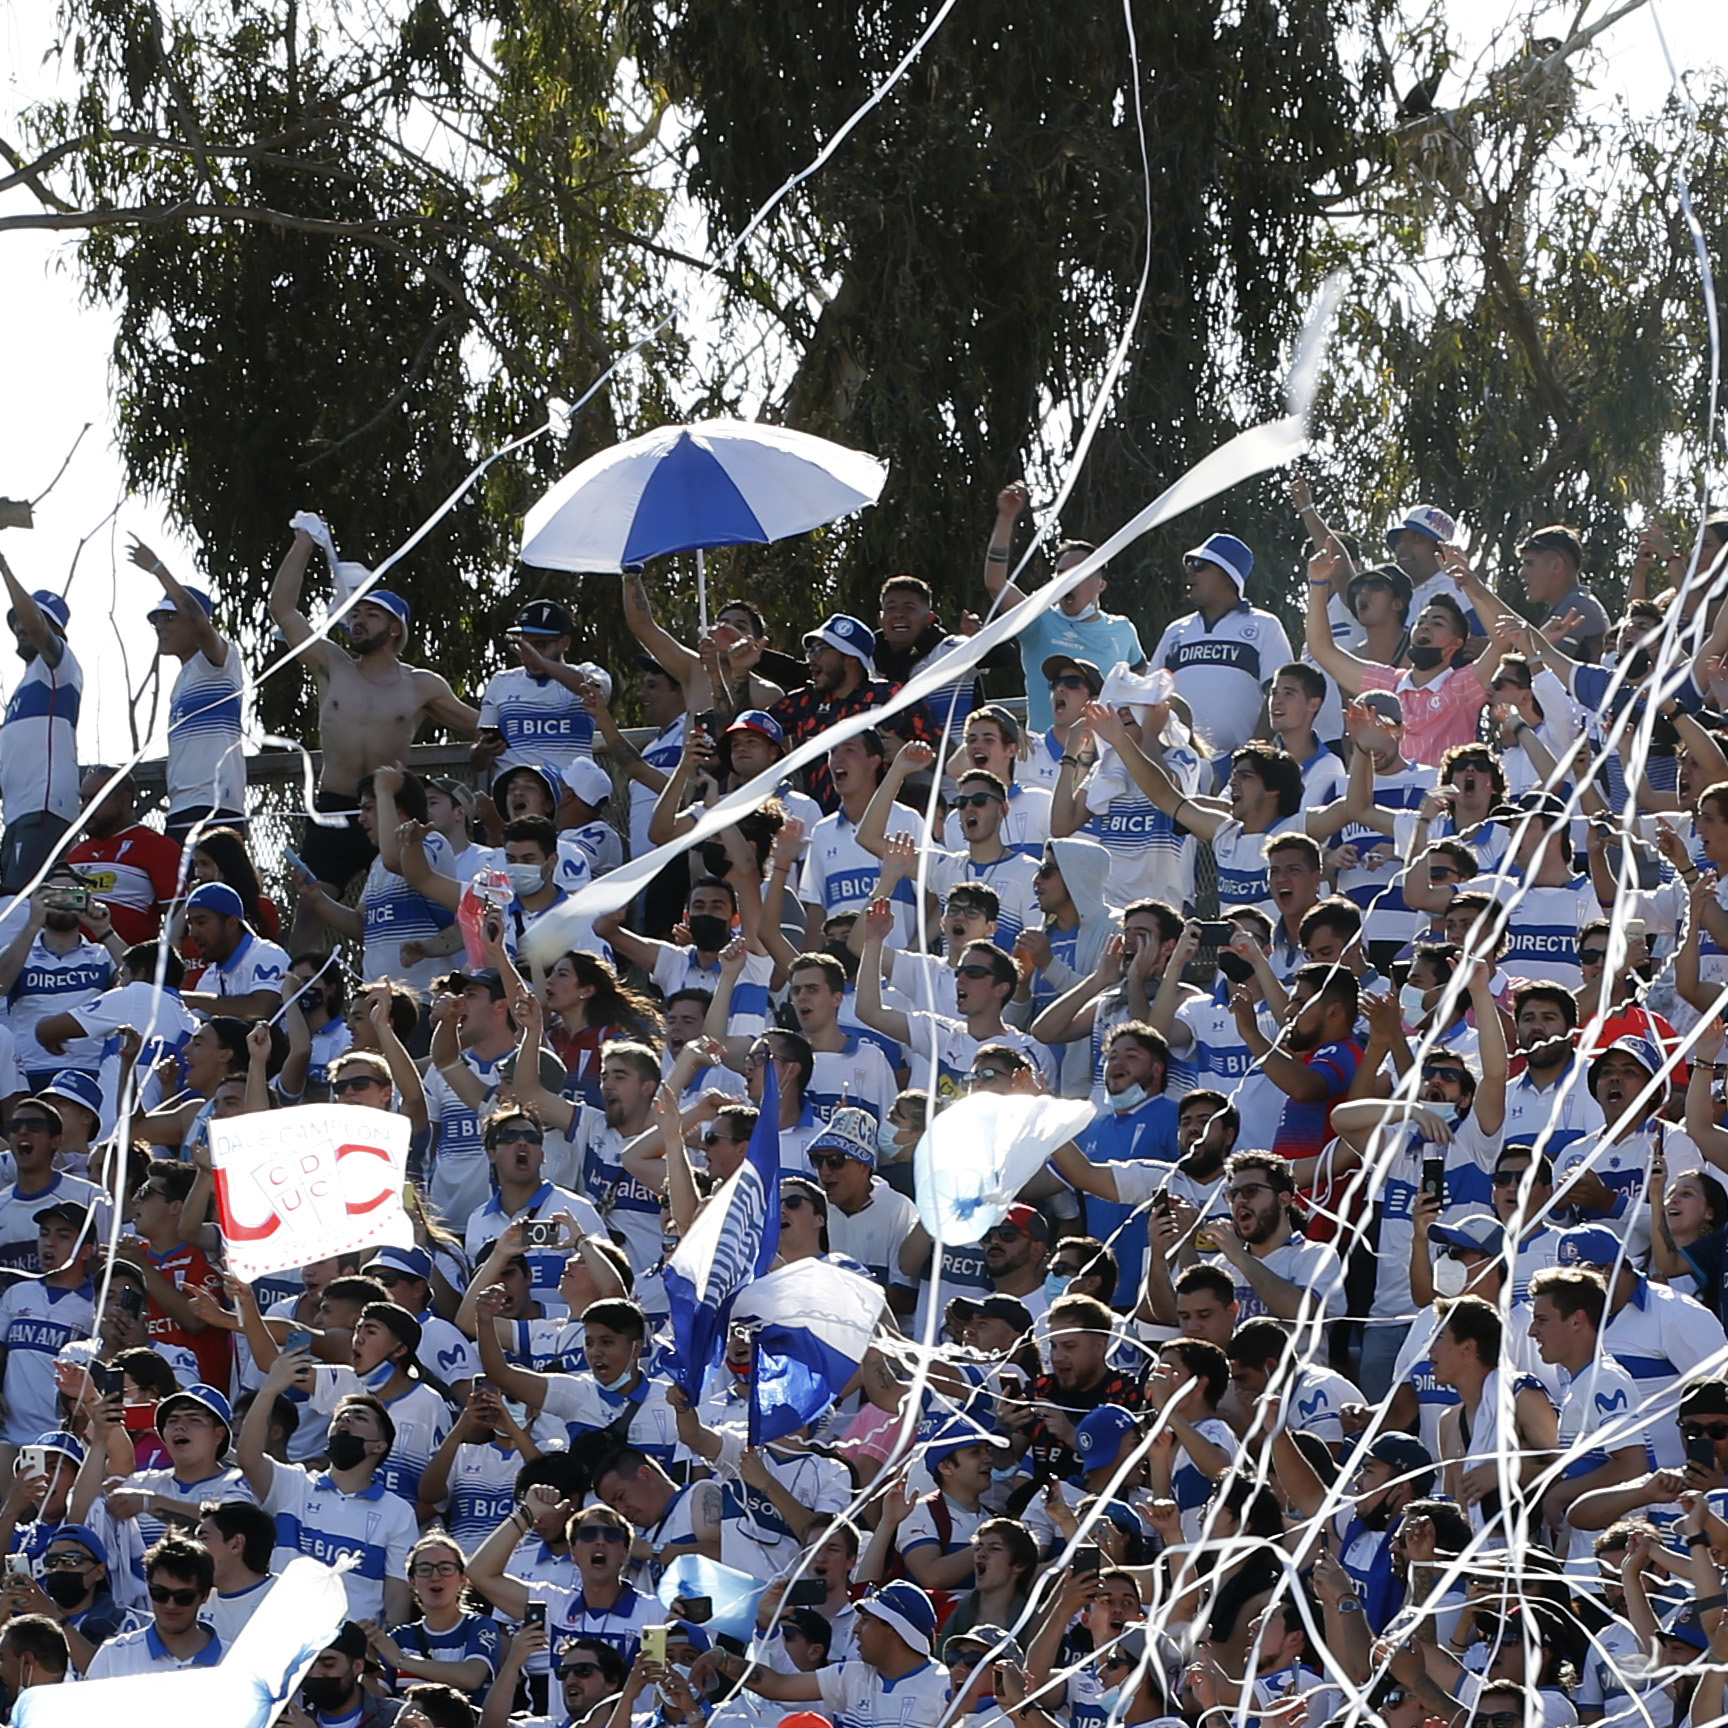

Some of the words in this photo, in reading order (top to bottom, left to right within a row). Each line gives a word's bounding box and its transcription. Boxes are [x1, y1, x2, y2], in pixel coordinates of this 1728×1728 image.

[1179, 644, 1239, 662] DIRECTV
[523, 719, 570, 734] BICE
[1110, 814, 1155, 832] BICE
[26, 970, 98, 988] DIRECTV
[268, 1164, 285, 1187] C
[301, 1155, 320, 1175] D
[281, 1192, 300, 1214] U
[309, 1180, 330, 1201] C
[38, 1329, 65, 1346] AM
